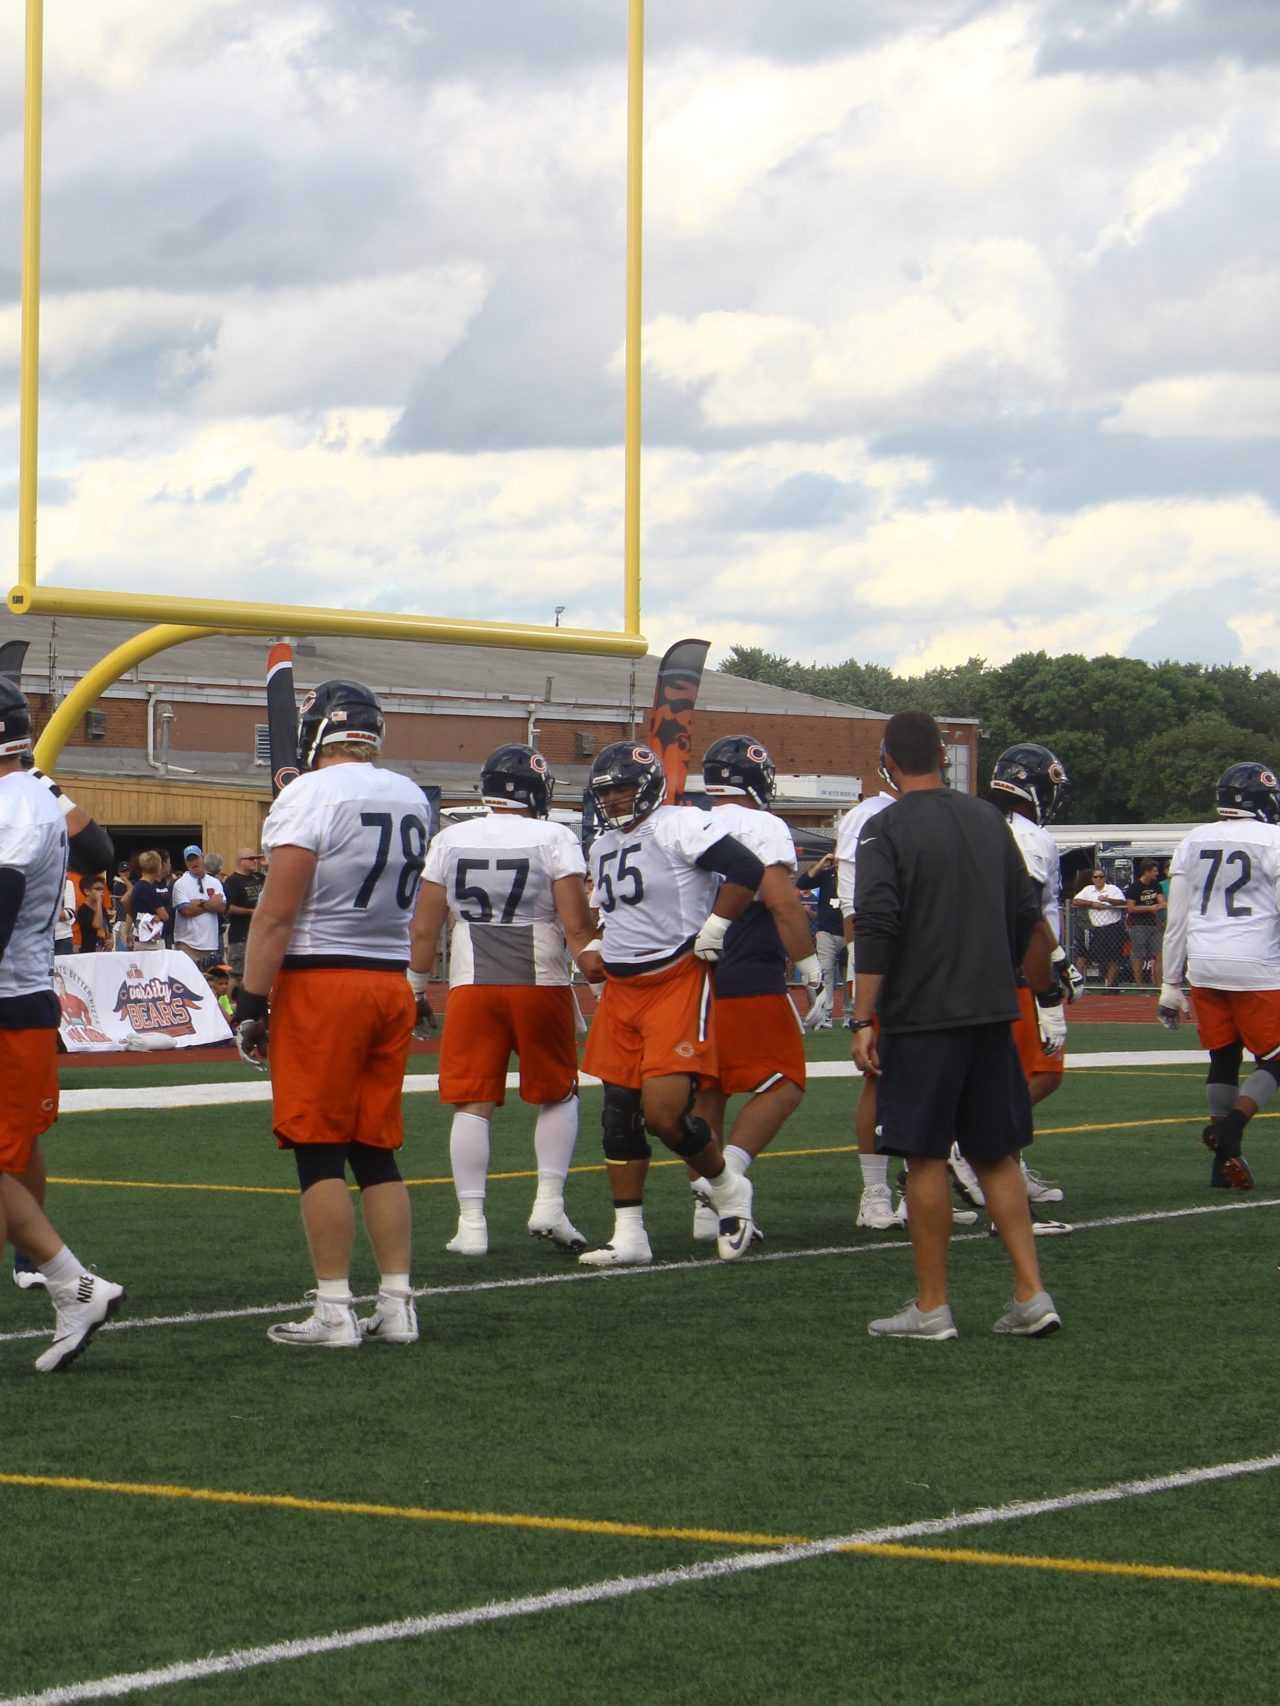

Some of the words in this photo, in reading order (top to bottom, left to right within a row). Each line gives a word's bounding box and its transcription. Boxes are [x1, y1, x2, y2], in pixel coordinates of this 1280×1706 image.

[353, 812, 426, 910] 78
[455, 858, 530, 923] 57
[598, 843, 644, 913] 55
[1199, 849, 1252, 917] 72
[127, 998, 189, 1030] BEARS
[129, 978, 171, 1004] varsity
[77, 1275, 95, 1303] NIKE
